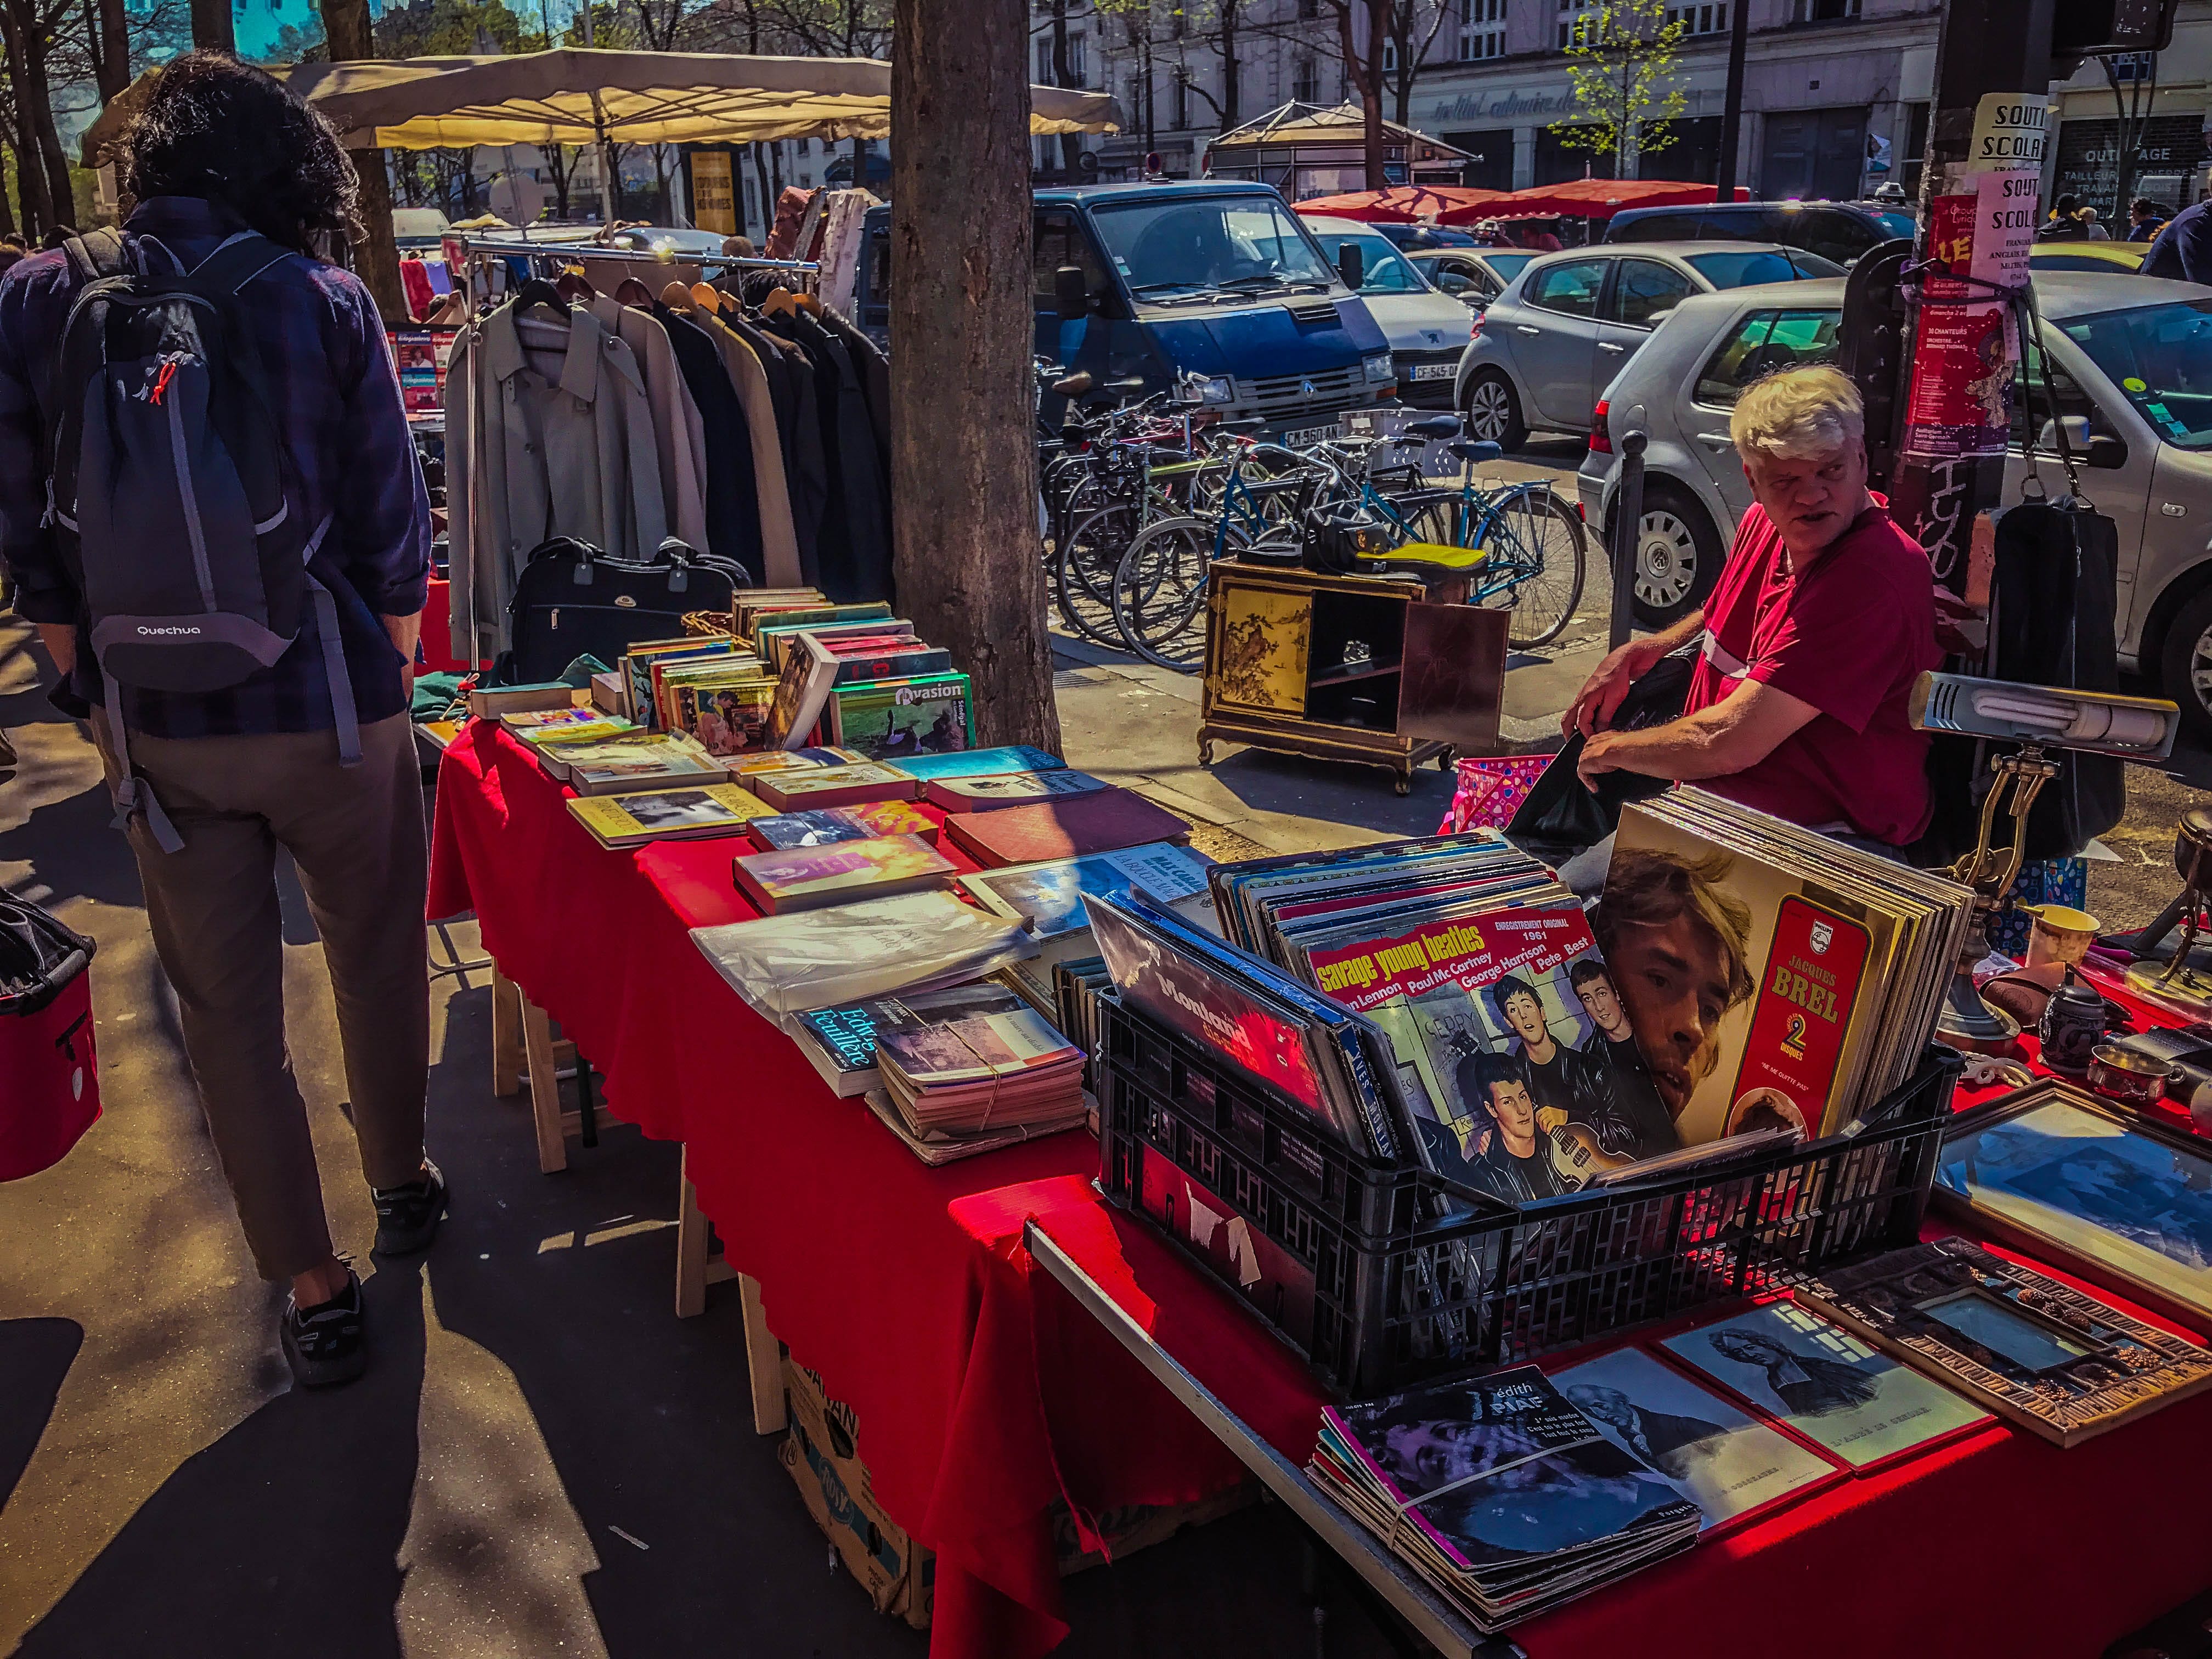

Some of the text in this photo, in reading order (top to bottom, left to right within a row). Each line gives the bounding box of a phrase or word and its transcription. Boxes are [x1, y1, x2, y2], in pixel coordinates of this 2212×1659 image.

[1995, 105, 2045, 127] SOUTI
[1982, 137, 2040, 157] SCOLA
[2086, 149, 2171, 162] OUTIAGE
[2064, 171, 2118, 180] TAILLEUR
[2004, 178, 2038, 198] SOUT
[1953, 215, 1976, 227] Lyriq
[1992, 210, 2036, 229] SCOLA
[137, 625, 201, 636] Quechua
[1543, 918, 1569, 928] ORIGINAL
[1814, 922, 1832, 934] PHILIPS
[1523, 931, 1548, 941] 1961
[1317, 925, 1486, 992] savage young beatles
[1536, 936, 1589, 970] Pete Best
[1461, 943, 1547, 988] George Harrison
[1788, 954, 1837, 987] JACQUES
[1357, 982, 1402, 1007] Lennon
[1407, 974, 1435, 994] Paul
[1435, 969, 1452, 984] Mc
[1450, 951, 1492, 975] Cartney
[1771, 965, 1839, 1024] BREL
[1154, 971, 1254, 1052] Montand
[808, 1008, 870, 1066] Feuillère
[838, 1007, 878, 1054] Edwig
[1782, 1013, 1807, 1052] 2
[1780, 1042, 1804, 1061] DISQUES
[1352, 1052, 1370, 1088] YVES
[1770, 1066, 1778, 1075] ME
[1778, 1070, 1796, 1086] QUITTE
[1369, 1101, 1395, 1160] MONTAN
[1497, 1382, 1533, 1398] édith
[1489, 1396, 1543, 1414] PIAF
[1579, 1427, 1595, 1435] camp
